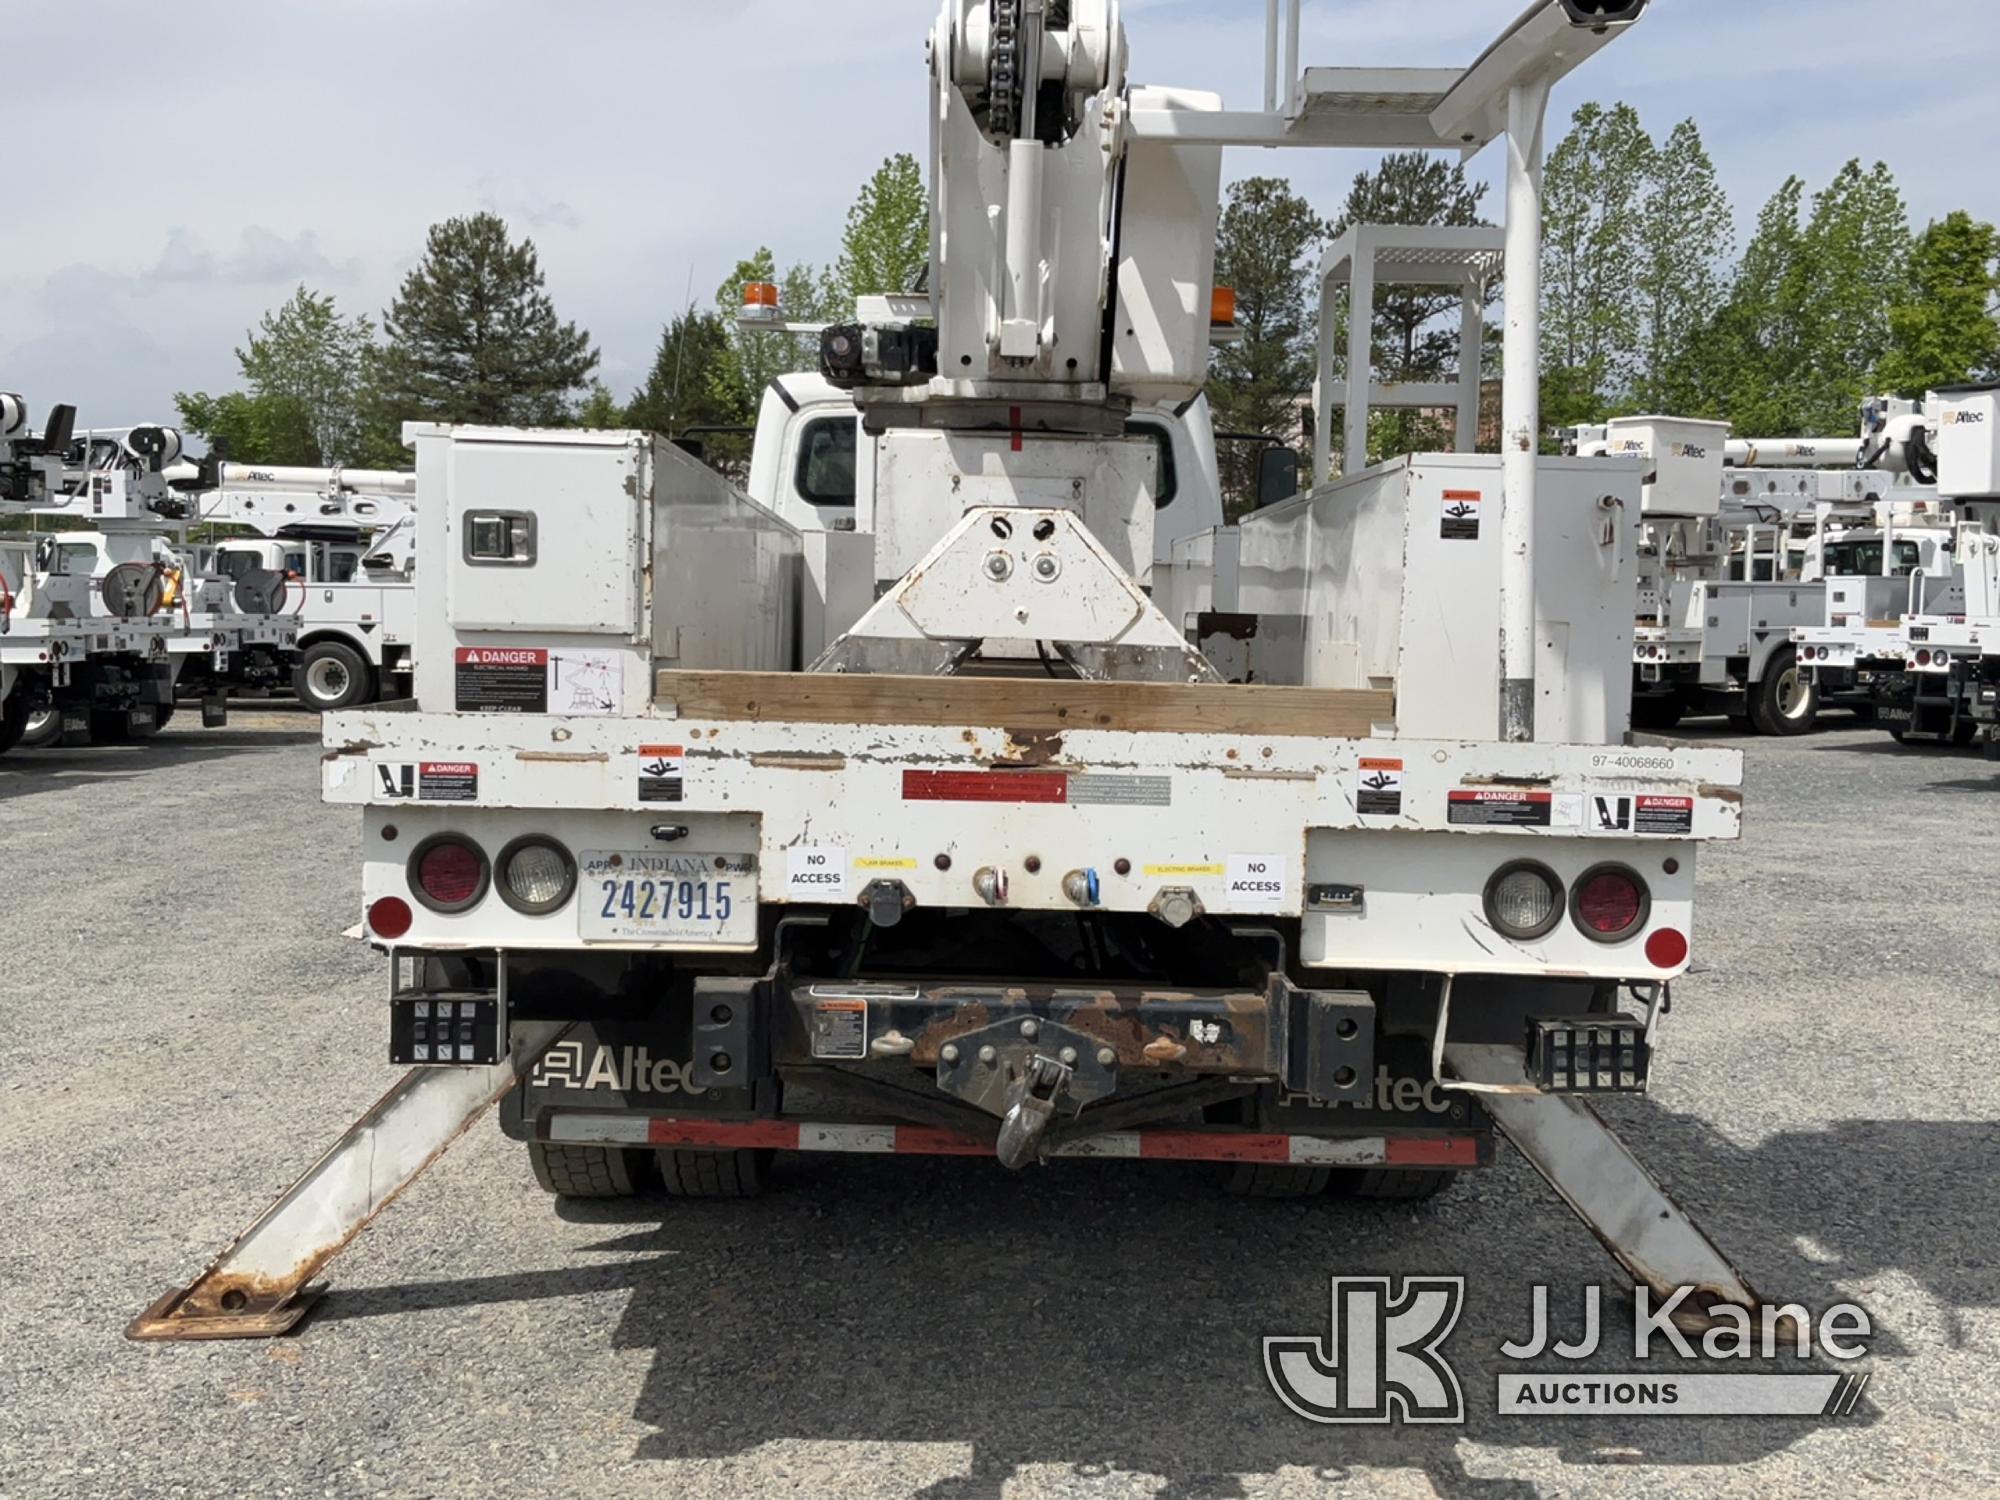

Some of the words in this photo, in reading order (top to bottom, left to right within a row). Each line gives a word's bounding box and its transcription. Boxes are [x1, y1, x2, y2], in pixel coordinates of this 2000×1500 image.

[1955, 411, 1983, 424] Altec
[1682, 443, 1705, 458] Altec
[1795, 444, 1815, 457] Altec
[247, 471, 275, 482] Altec
[482, 651, 536, 663] DANGER
[1592, 755, 1674, 769] 97-40068660
[437, 764, 471, 773] DANGER
[1484, 792, 1527, 801] DANGER
[1652, 798, 1686, 807] DANGER
[628, 858, 709, 873] INDIANA
[807, 855, 826, 865] NO
[1247, 863, 1267, 873] NO
[791, 873, 841, 883] ACCESS
[1232, 881, 1281, 891] ACCESS
[601, 879, 731, 920] 2427915
